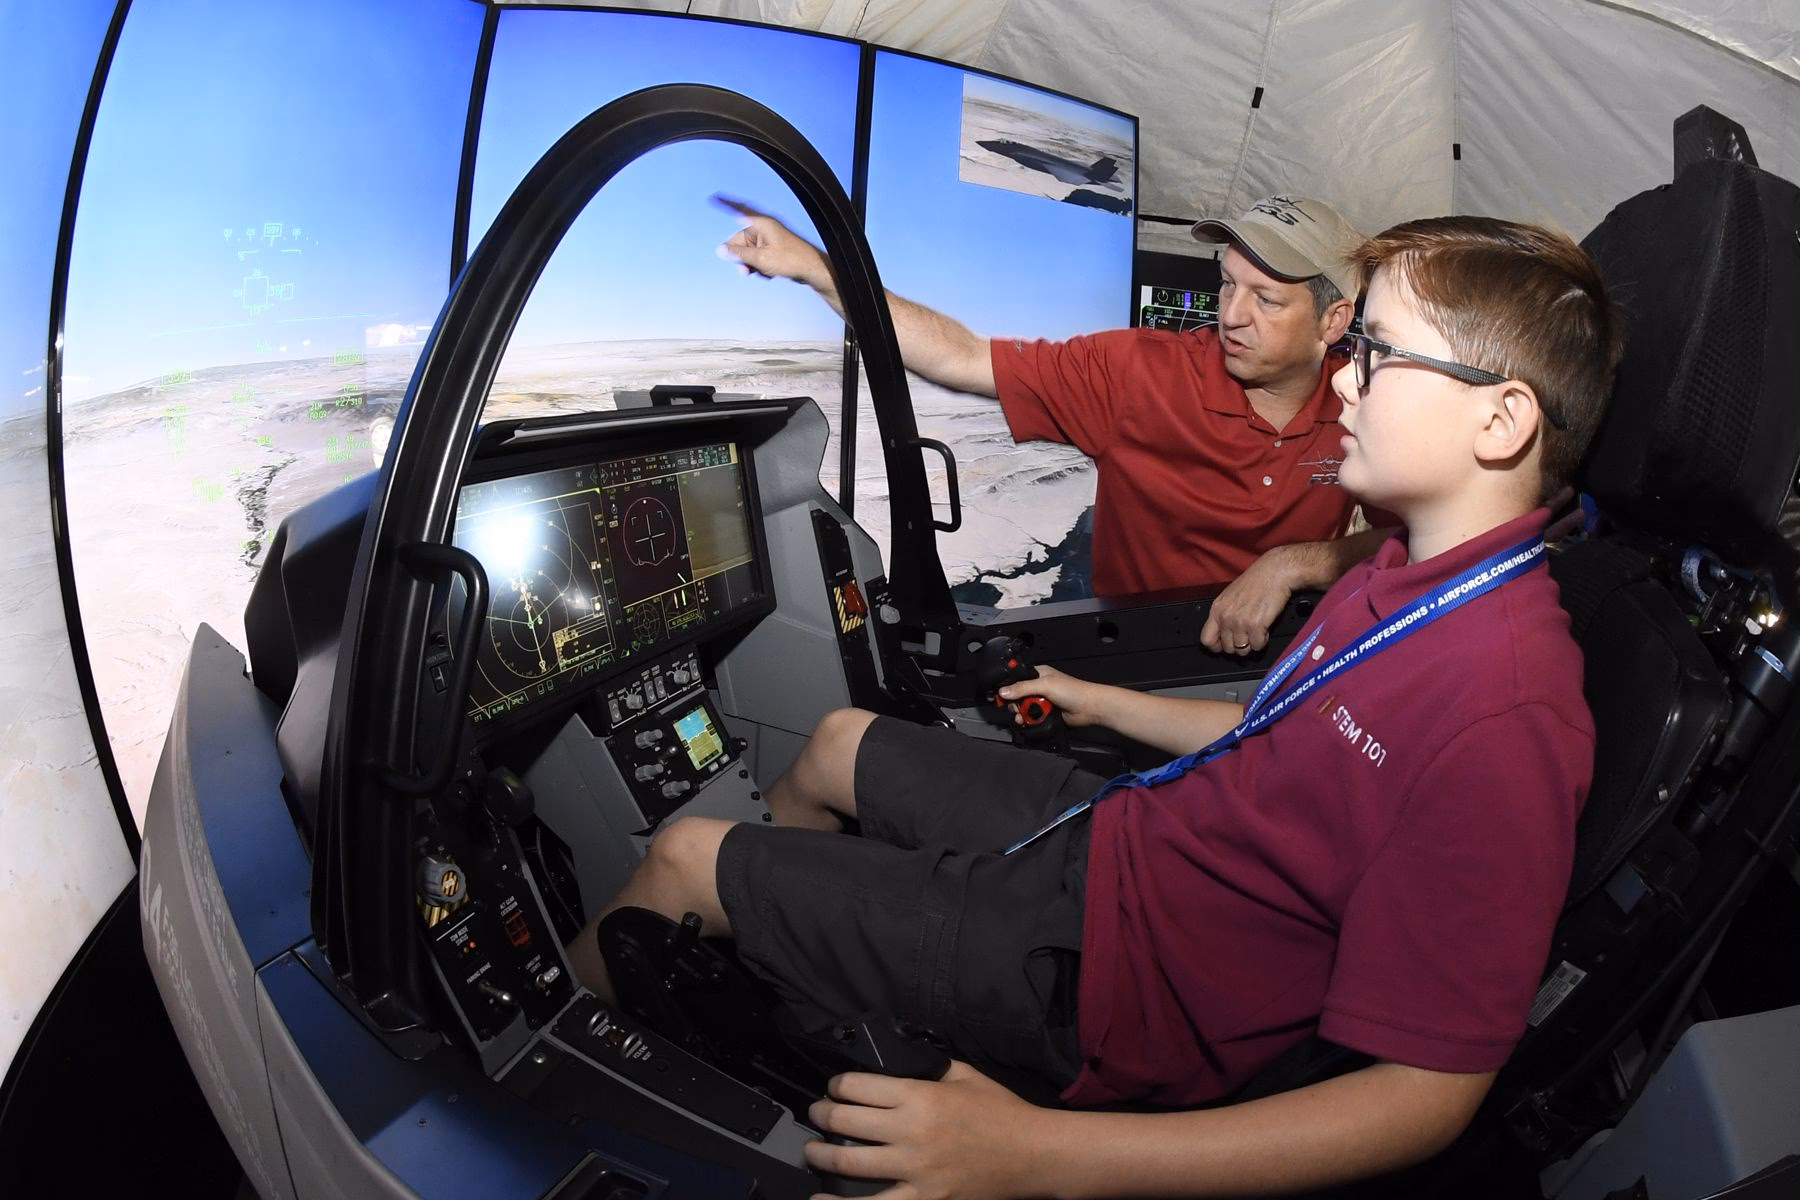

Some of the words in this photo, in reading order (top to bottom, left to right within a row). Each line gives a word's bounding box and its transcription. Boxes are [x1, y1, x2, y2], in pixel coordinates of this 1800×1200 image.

[1268, 701, 1284, 717] AIR
[1284, 676, 1316, 706] FORCE
[1322, 649, 1358, 678] HEALTH
[1359, 605, 1428, 654] PROFESSIONS
[1332, 705, 1363, 745] STEM
[1361, 734, 1388, 768] 101
